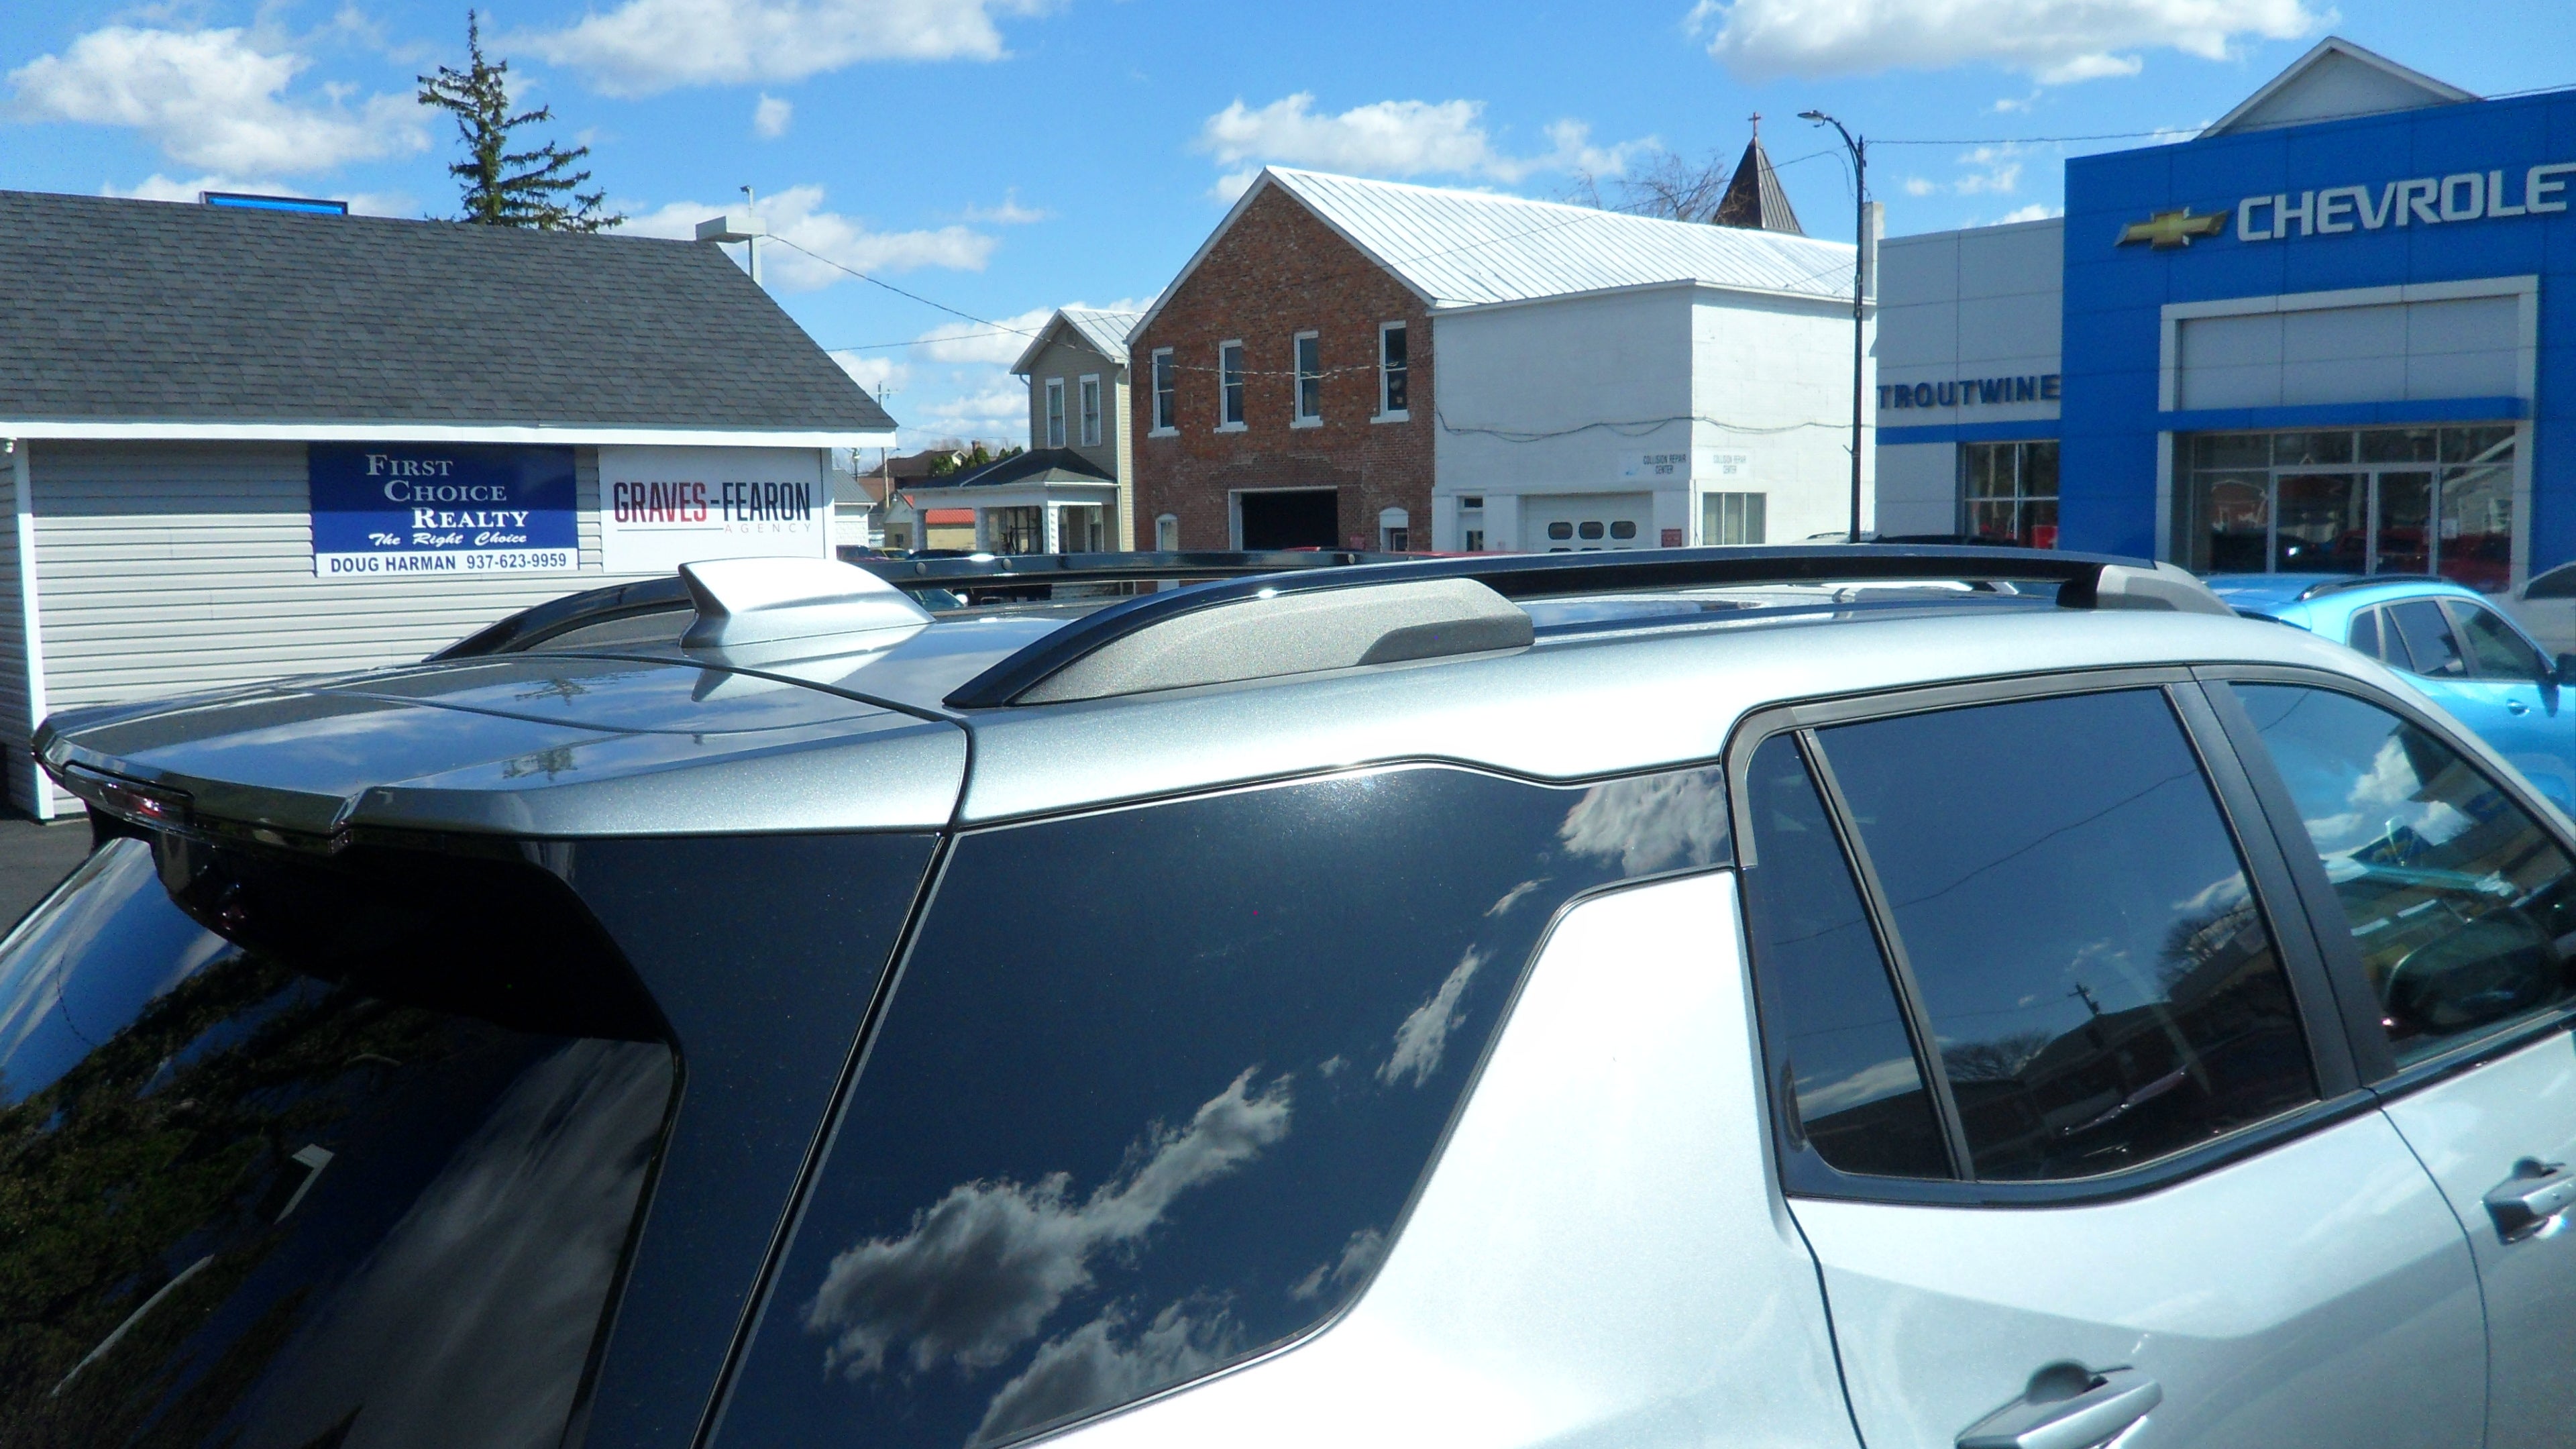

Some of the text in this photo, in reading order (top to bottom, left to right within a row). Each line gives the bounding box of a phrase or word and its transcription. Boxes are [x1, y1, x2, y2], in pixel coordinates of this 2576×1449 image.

[2237, 162, 2576, 241] CHEVROLE
[1877, 374, 2061, 409] TROUTWINE
[366, 454, 453, 476] FIRST
[1644, 454, 1686, 465] COLLISION REPAIR
[384, 480, 507, 502] CHOICE
[613, 482, 810, 523] GRAVES-FEARON
[411, 506, 529, 529] REALTY
[724, 523, 811, 534] AGENCY
[368, 531, 527, 547] The Right Choice
[330, 553, 567, 573] DOUG HARMAN 937-623-9959
